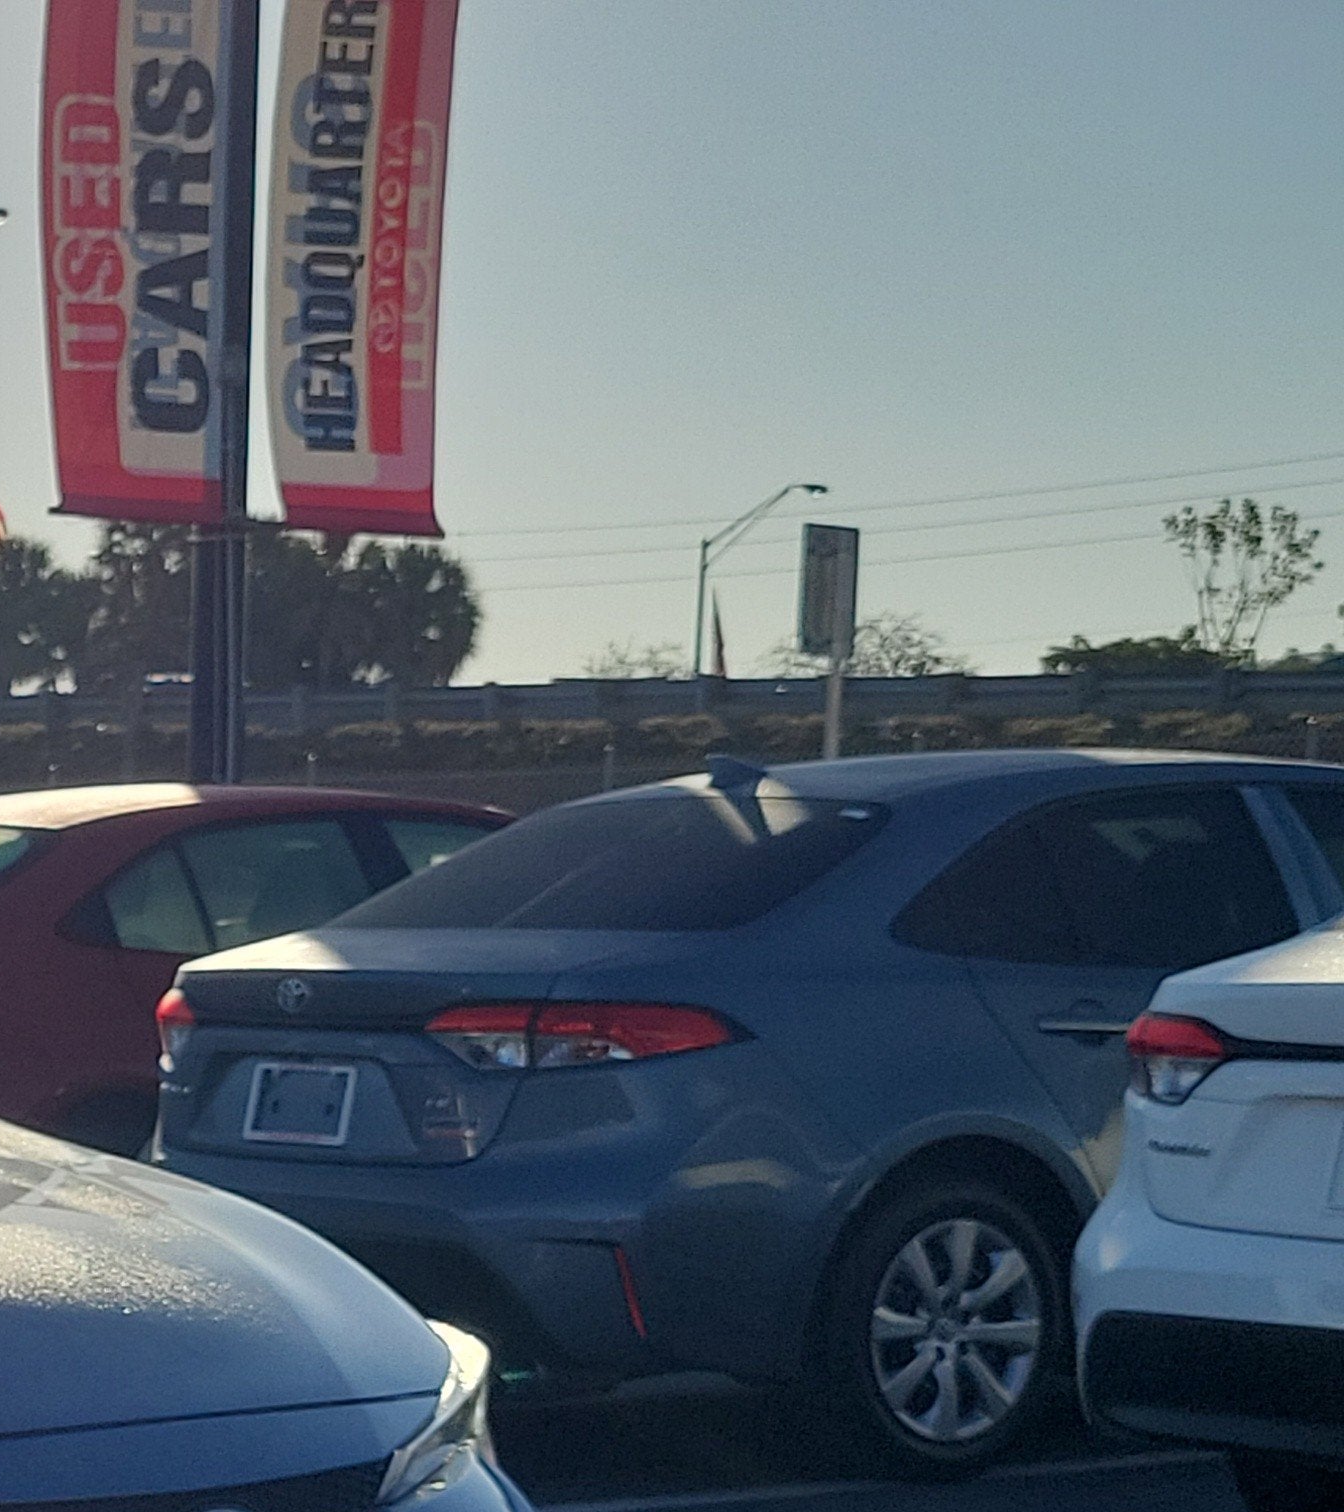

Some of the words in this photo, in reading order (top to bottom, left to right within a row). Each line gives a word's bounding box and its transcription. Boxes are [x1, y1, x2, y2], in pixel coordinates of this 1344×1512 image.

[55, 97, 127, 369] USED
[130, 57, 215, 433] CARS
[373, 121, 411, 287] TOYOTA
